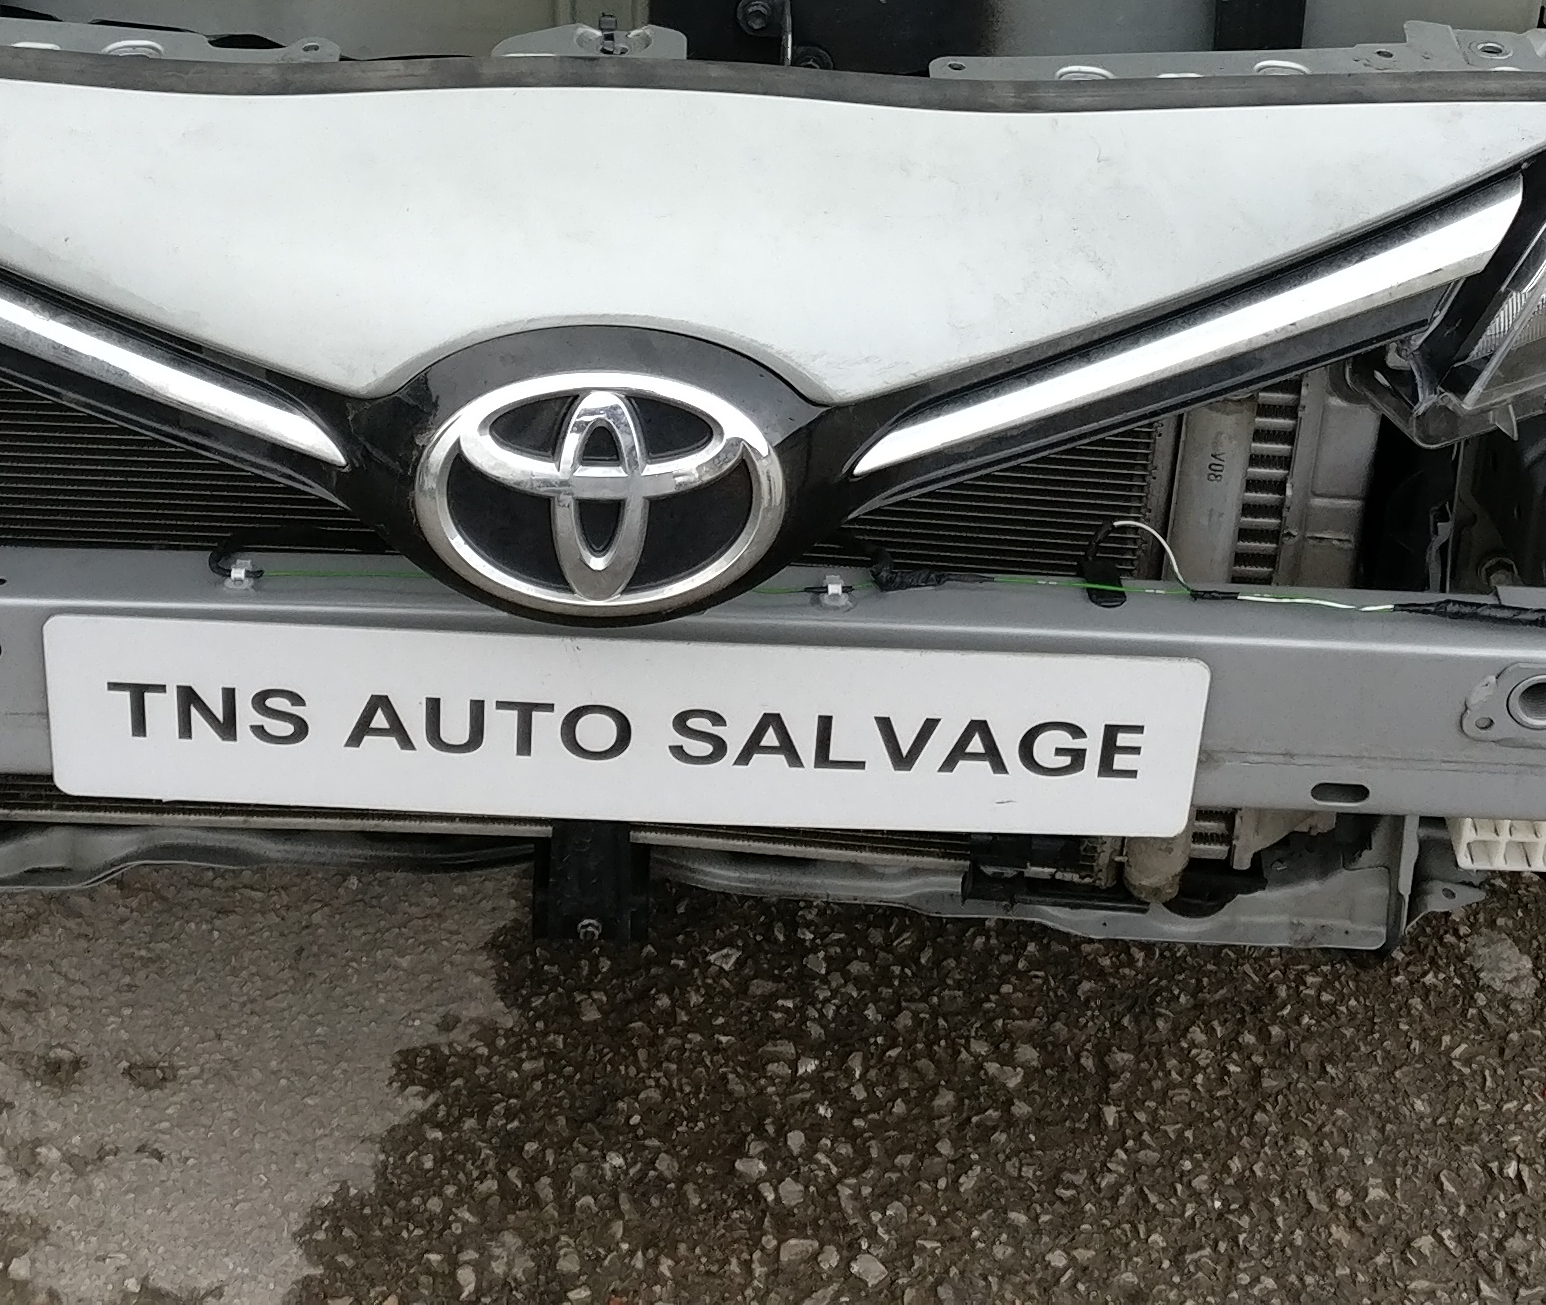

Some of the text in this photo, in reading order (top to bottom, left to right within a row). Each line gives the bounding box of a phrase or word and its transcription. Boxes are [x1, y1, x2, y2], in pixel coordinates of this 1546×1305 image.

[106, 681, 1145, 779] TNS AUTO SALVAGE
